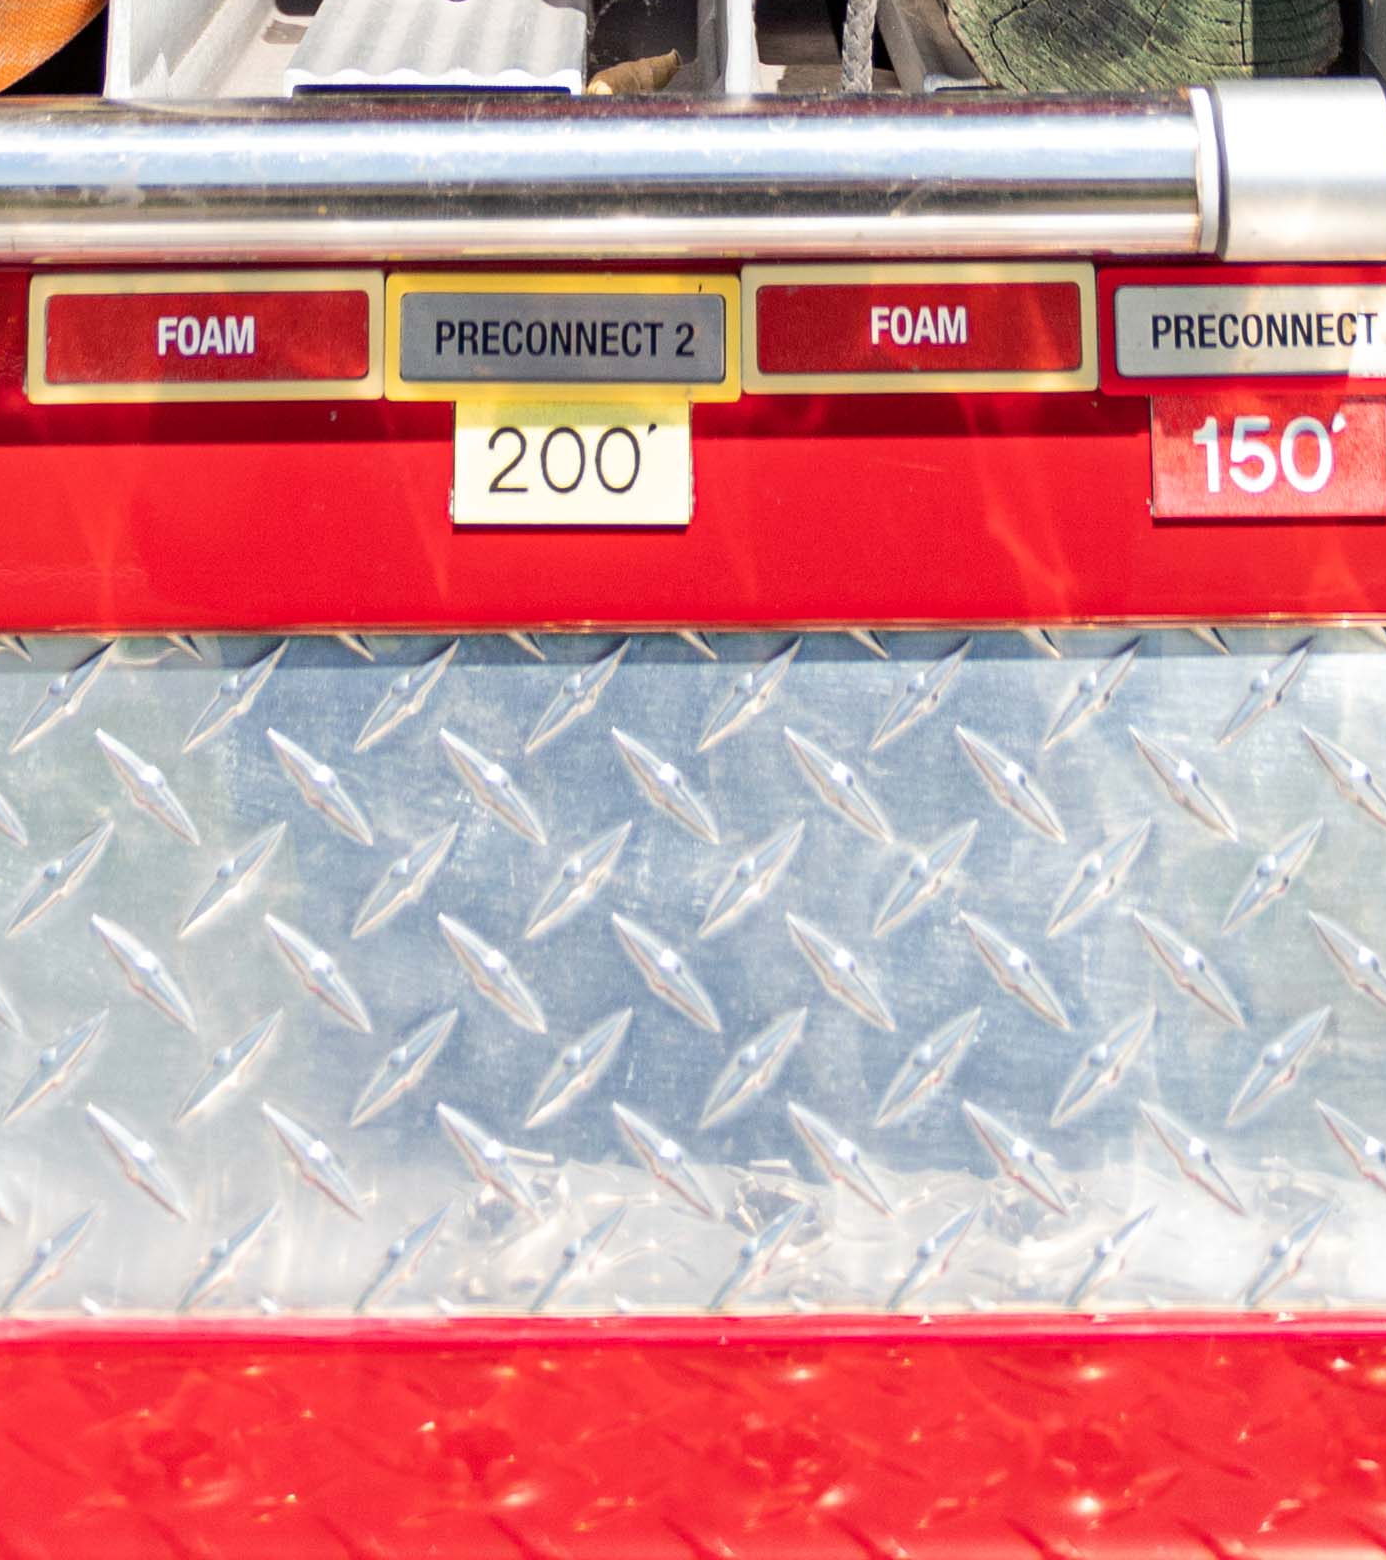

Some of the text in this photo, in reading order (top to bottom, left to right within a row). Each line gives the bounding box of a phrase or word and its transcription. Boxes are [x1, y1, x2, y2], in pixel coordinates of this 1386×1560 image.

[157, 315, 255, 357] FOAM
[436, 320, 696, 358] PRECONNECT 2
[870, 306, 968, 345] FOAM
[1151, 312, 1379, 350] PRECONNECT
